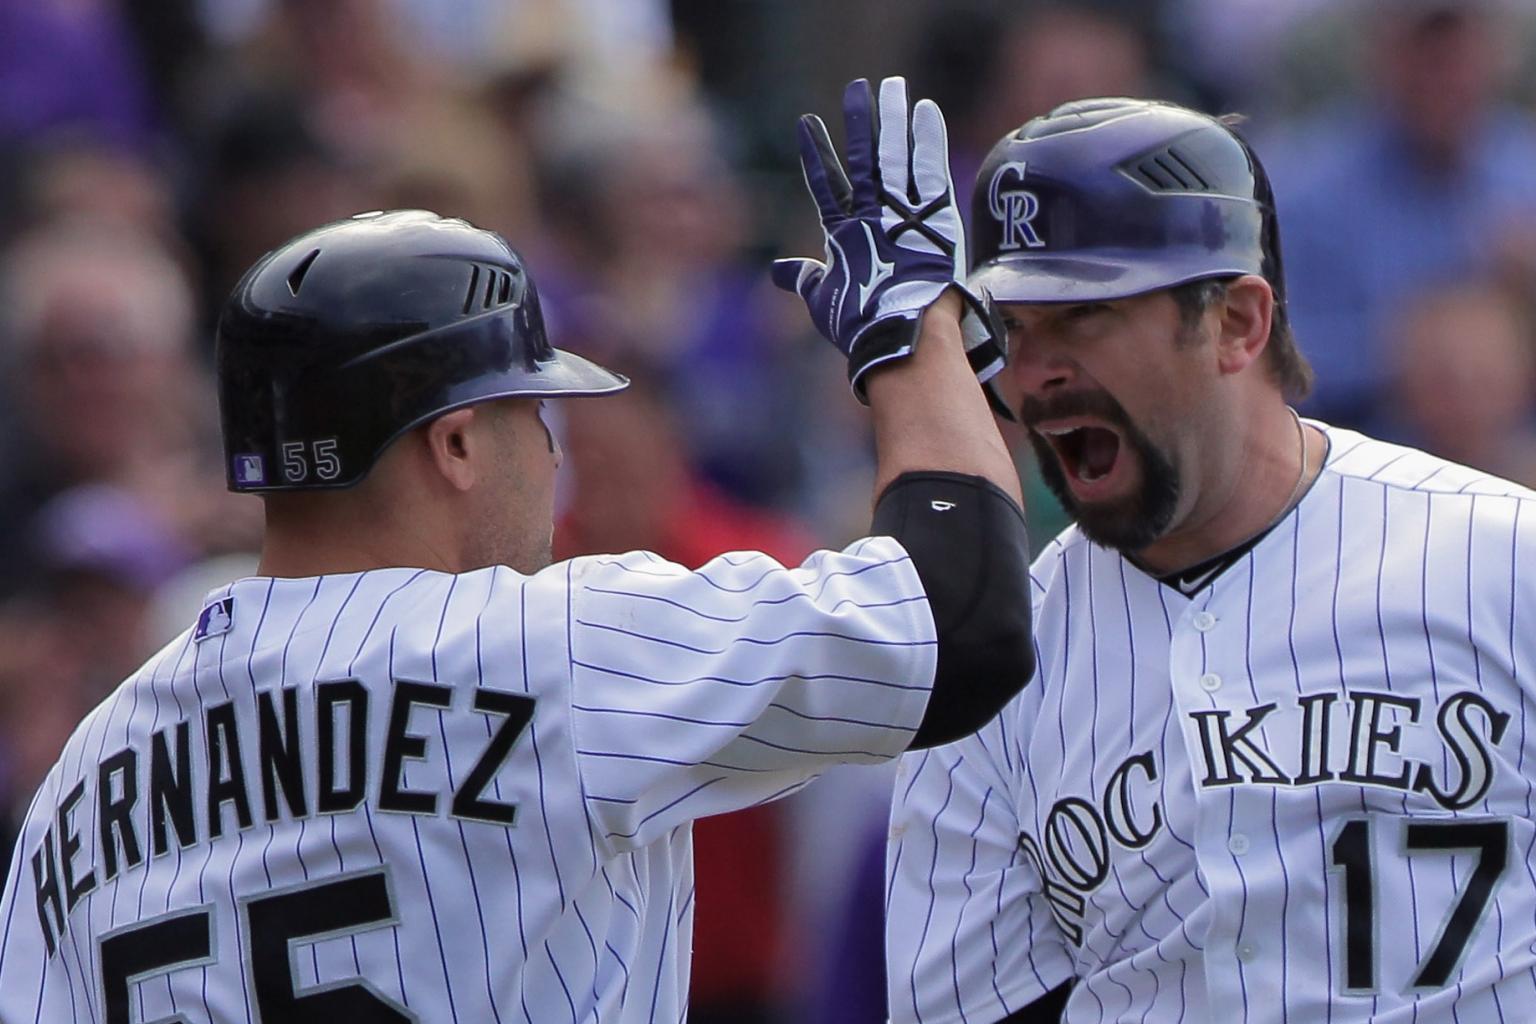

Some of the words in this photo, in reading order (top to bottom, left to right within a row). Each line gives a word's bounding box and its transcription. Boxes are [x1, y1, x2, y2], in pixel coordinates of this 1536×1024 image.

[282, 439, 341, 482] 55
[31, 676, 538, 960] HERNANDEZ
[1328, 814, 1515, 997] 17
